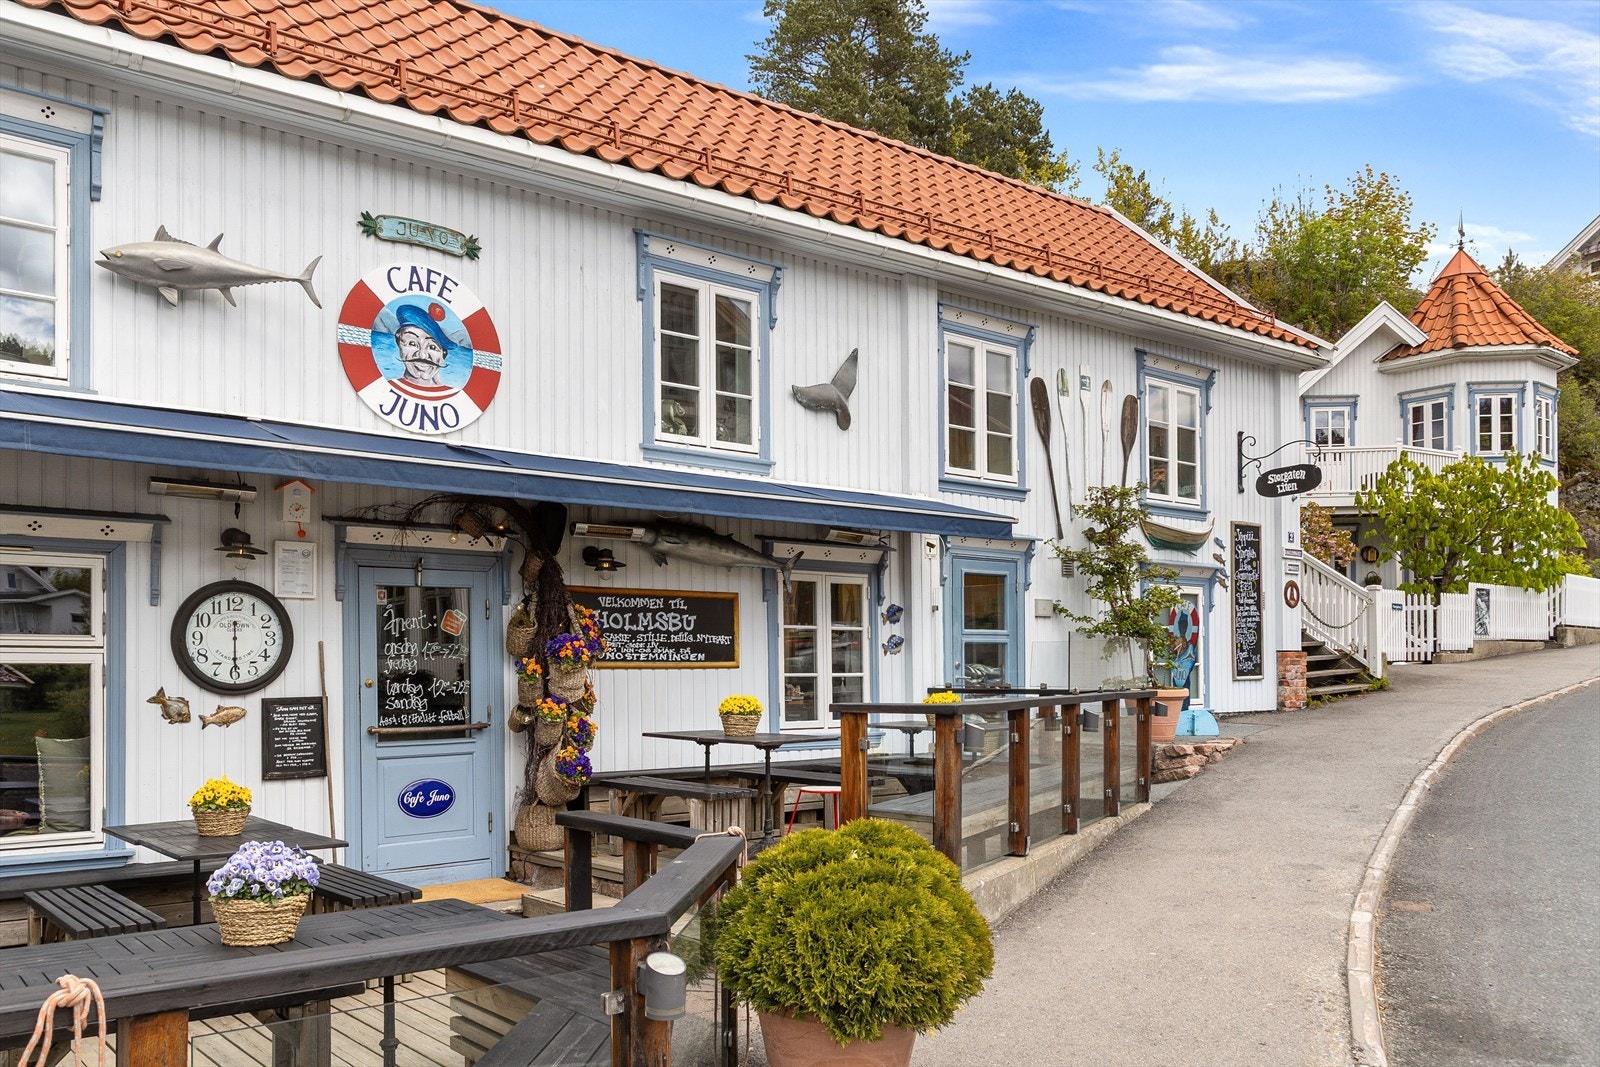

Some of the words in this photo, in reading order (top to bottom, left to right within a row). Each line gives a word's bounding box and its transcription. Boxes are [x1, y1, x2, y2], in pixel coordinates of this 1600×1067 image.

[396, 221, 449, 245] JUNO
[386, 265, 459, 304] CAFE
[379, 388, 460, 431] JUNO
[1267, 469, 1306, 484] Storgaten
[210, 600, 221, 615] 11
[226, 597, 244, 611] 12
[251, 602, 257, 616] 1
[598, 596, 664, 608] VELKOMMEN
[669, 598, 687, 610] TIL
[195, 613, 211, 628] 10
[260, 614, 272, 629] 2
[593, 609, 697, 632] HOLMSBU
[192, 631, 203, 646] 9
[264, 631, 276, 646] 3
[196, 648, 208, 664] 8
[258, 648, 271, 662] 4
[211, 662, 222, 677] 7
[229, 664, 241, 680] 6
[247, 661, 258, 676] 5
[426, 789, 450, 806] Juno
